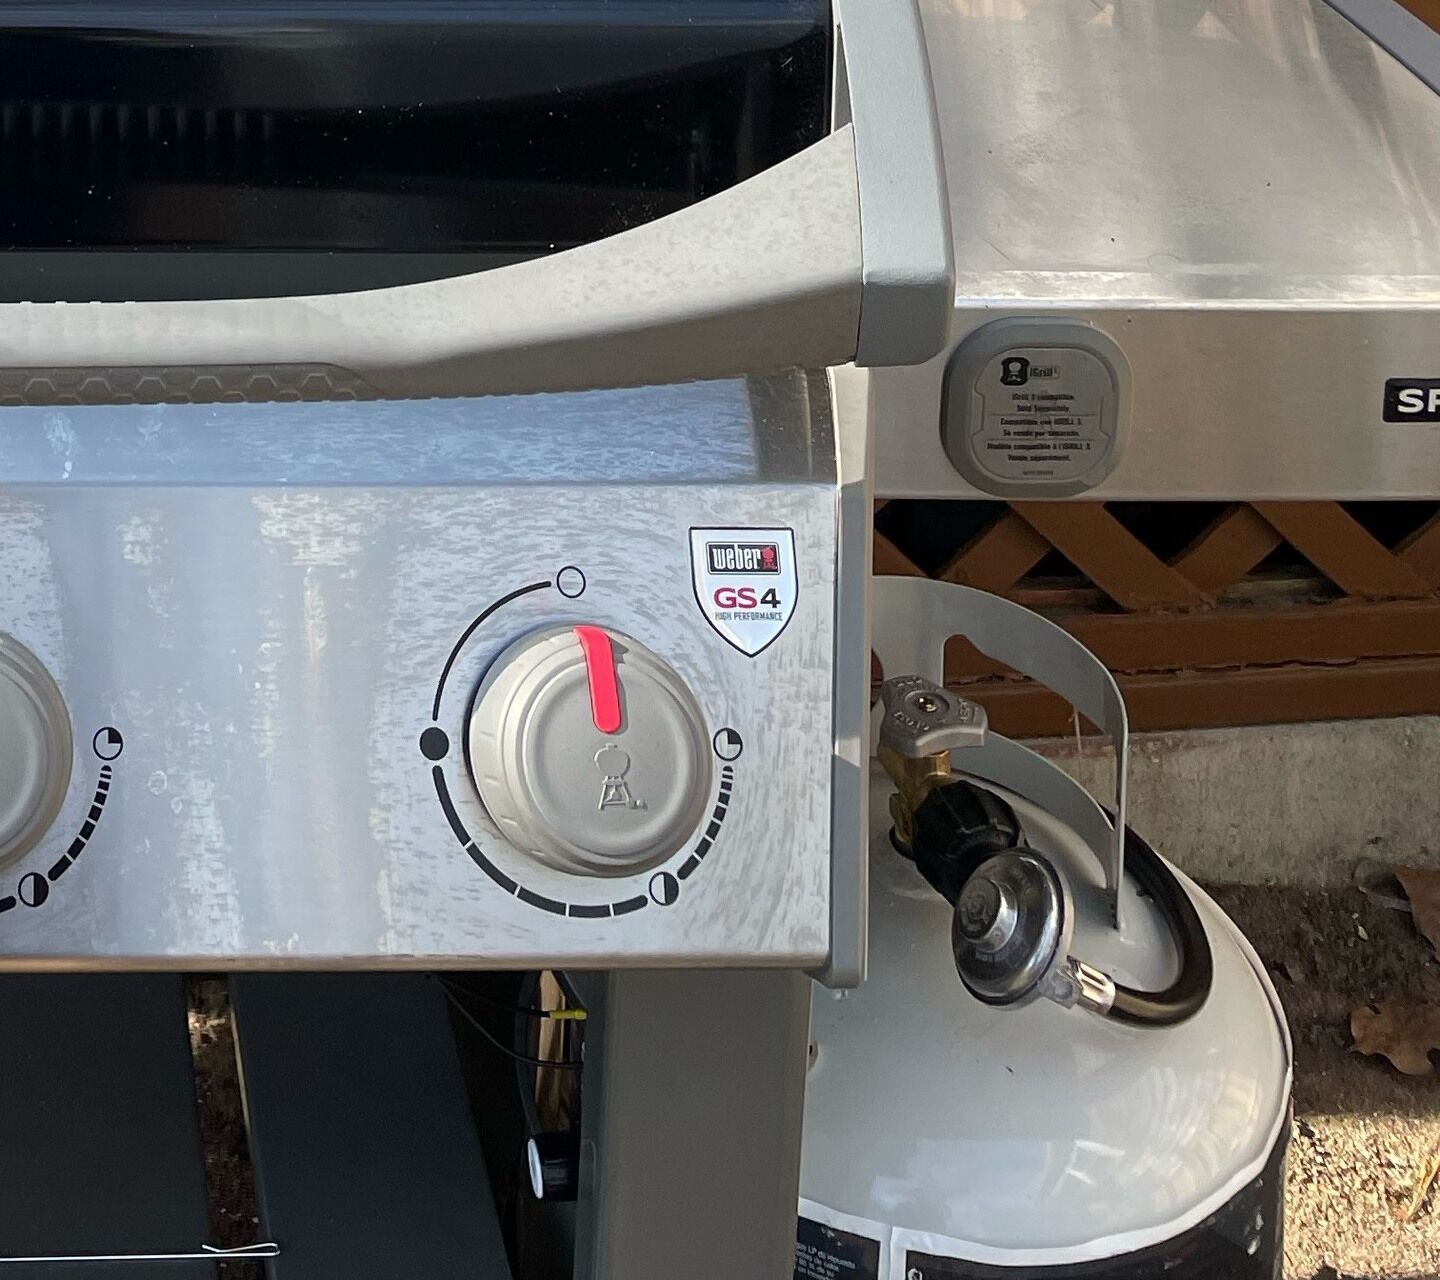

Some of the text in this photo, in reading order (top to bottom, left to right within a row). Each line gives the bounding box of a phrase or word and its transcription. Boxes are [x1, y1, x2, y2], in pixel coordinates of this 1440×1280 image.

[712, 544, 761, 570] weber
[713, 587, 781, 609] GS4
[733, 611, 783, 622] PERFORMANCE
